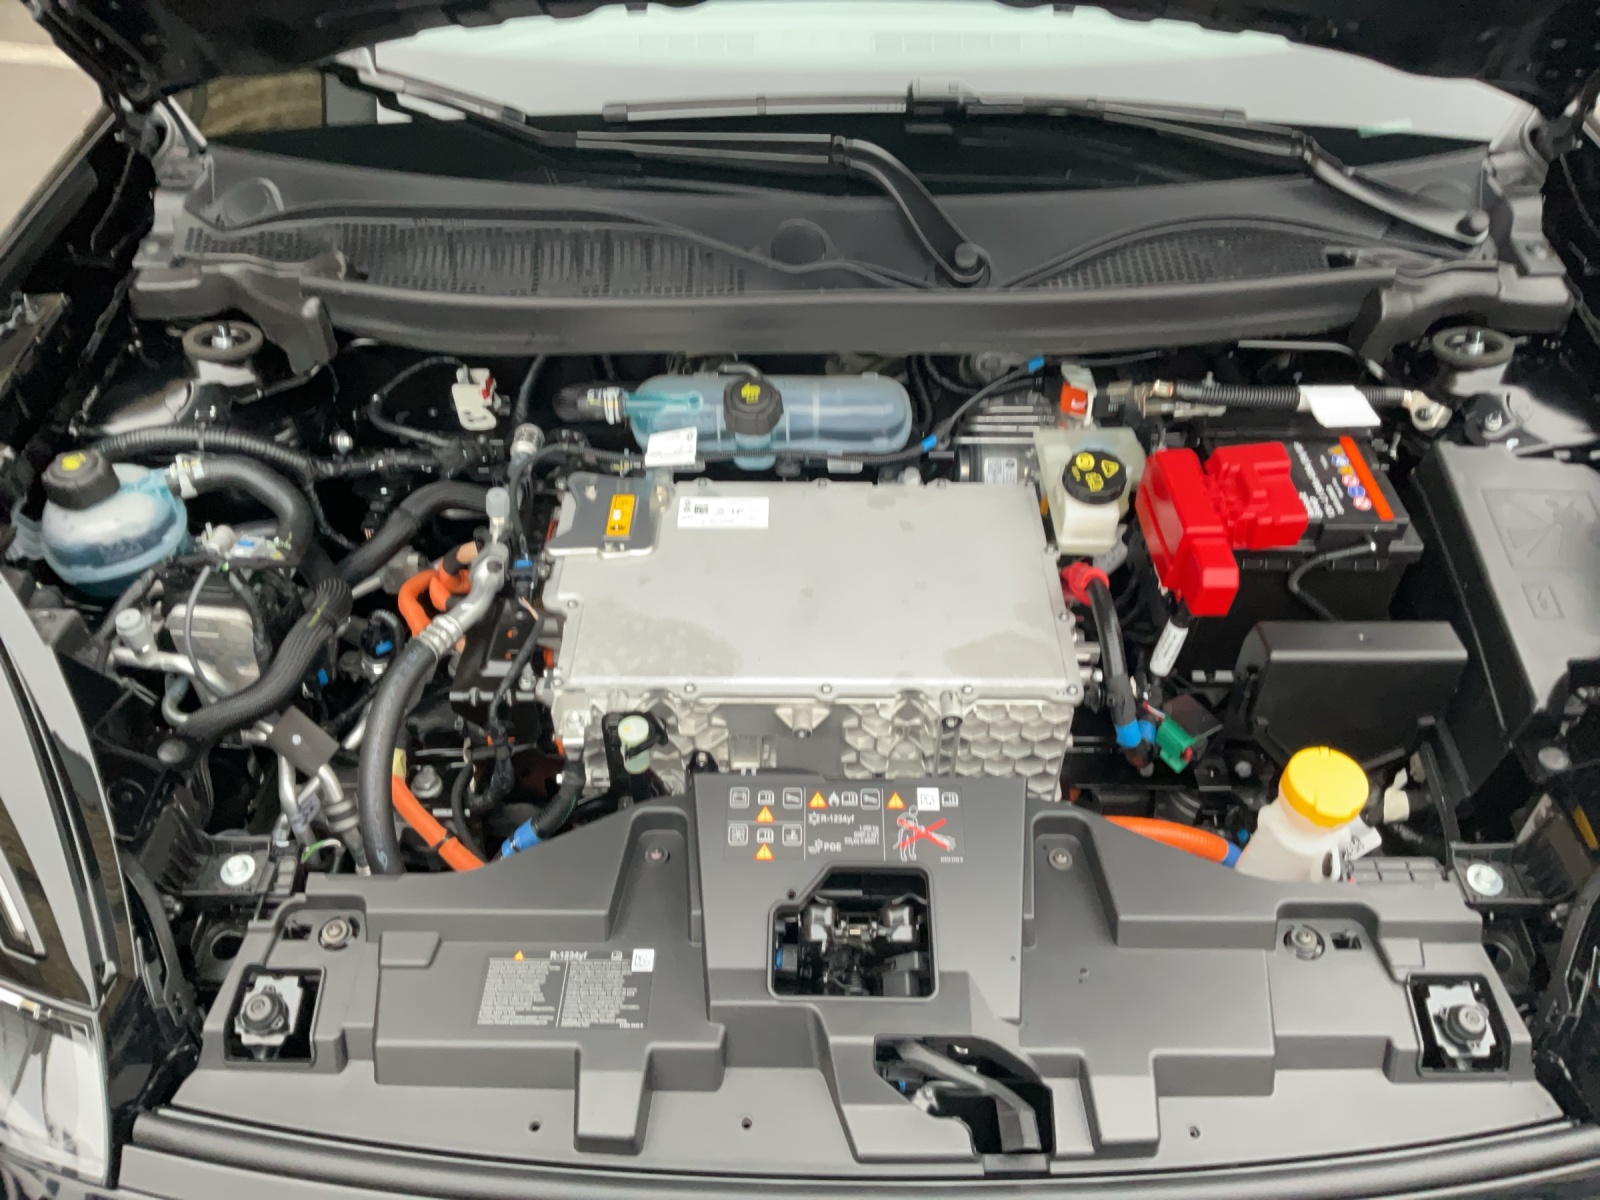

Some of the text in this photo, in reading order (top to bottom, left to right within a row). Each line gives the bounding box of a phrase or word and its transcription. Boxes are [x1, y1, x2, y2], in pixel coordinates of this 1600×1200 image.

[821, 813, 854, 825] R-1234yf
[824, 841, 841, 852] POE
[550, 950, 587, 961] R-1234yf
